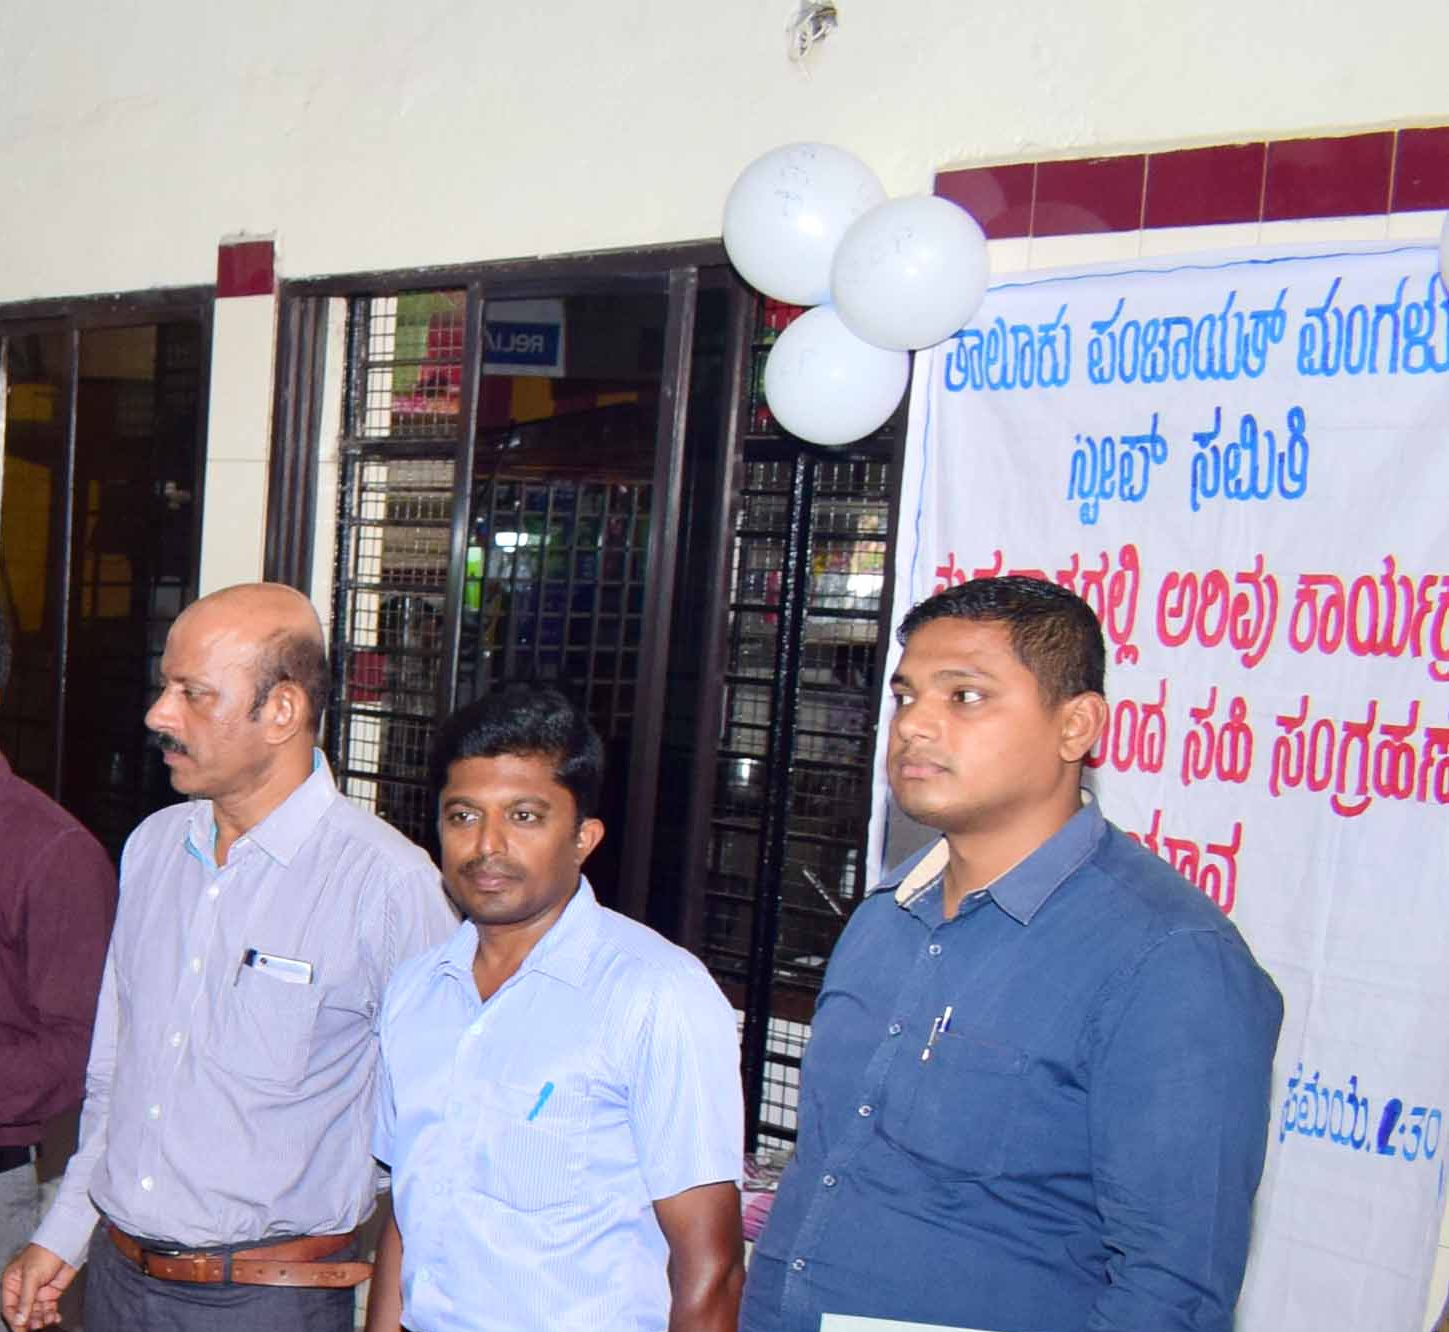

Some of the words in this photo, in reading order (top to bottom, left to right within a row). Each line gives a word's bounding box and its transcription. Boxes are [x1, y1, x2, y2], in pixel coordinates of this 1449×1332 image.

[1190, 405, 1310, 512] ಸಮಿತಿ
[1155, 552, 1279, 670] ಅರಿವು
[1182, 686, 1254, 786] ಸಹಿ
